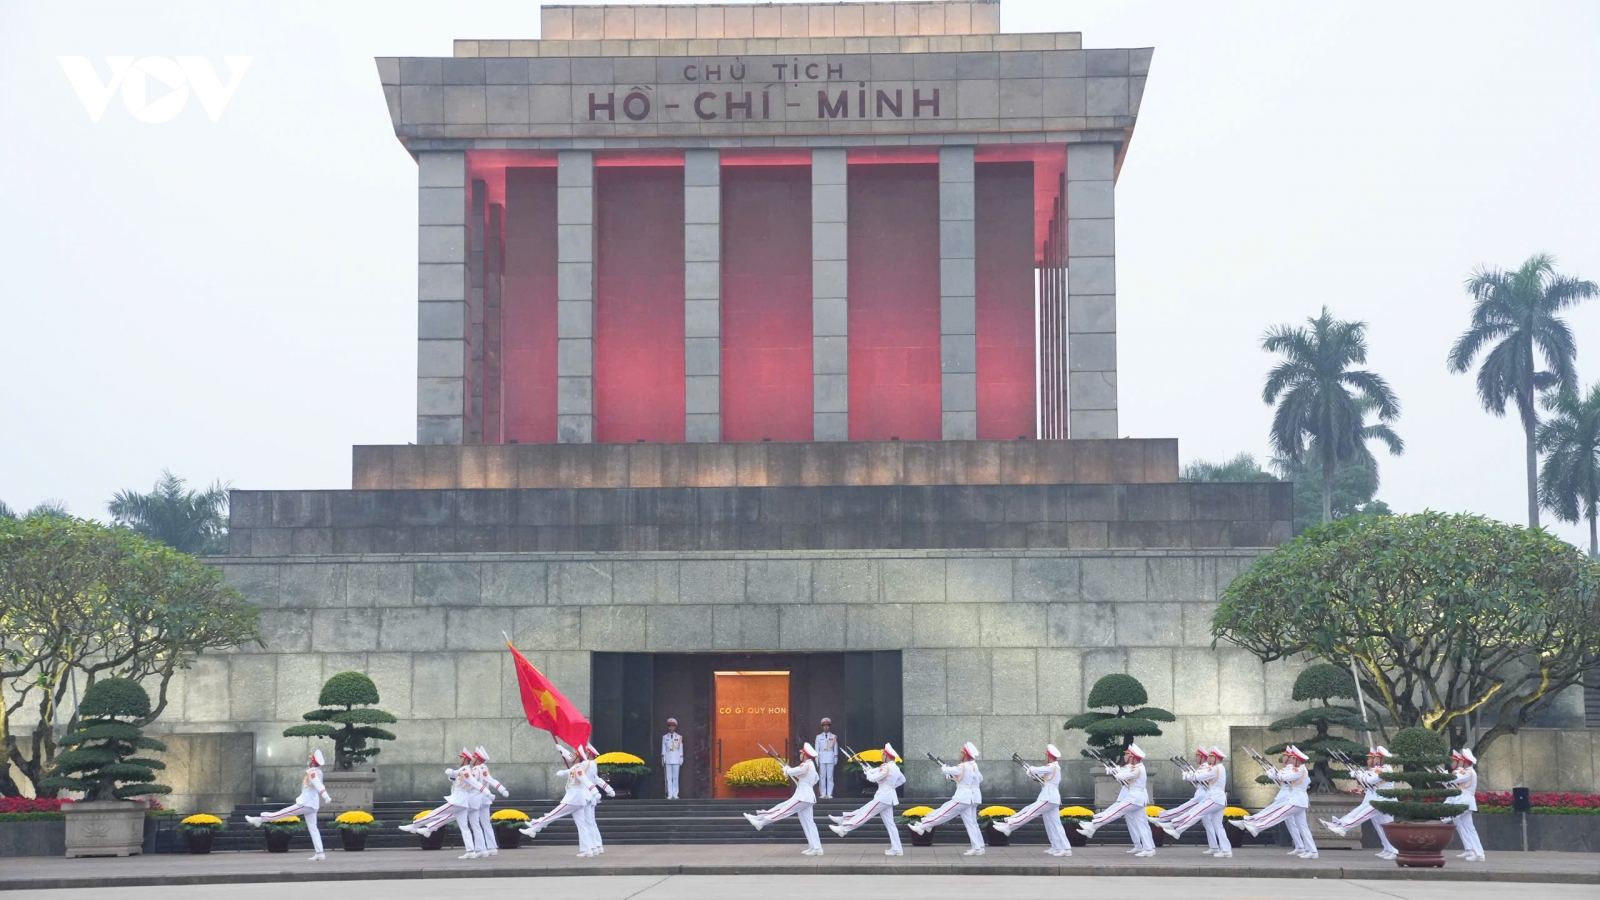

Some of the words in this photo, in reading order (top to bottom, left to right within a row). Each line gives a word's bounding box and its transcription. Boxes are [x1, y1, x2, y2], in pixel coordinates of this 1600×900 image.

[683, 56, 746, 82] CHỦ
[772, 57, 843, 88] TỊCH
[588, 85, 653, 121] HỒ
[693, 85, 774, 120] CHÍ
